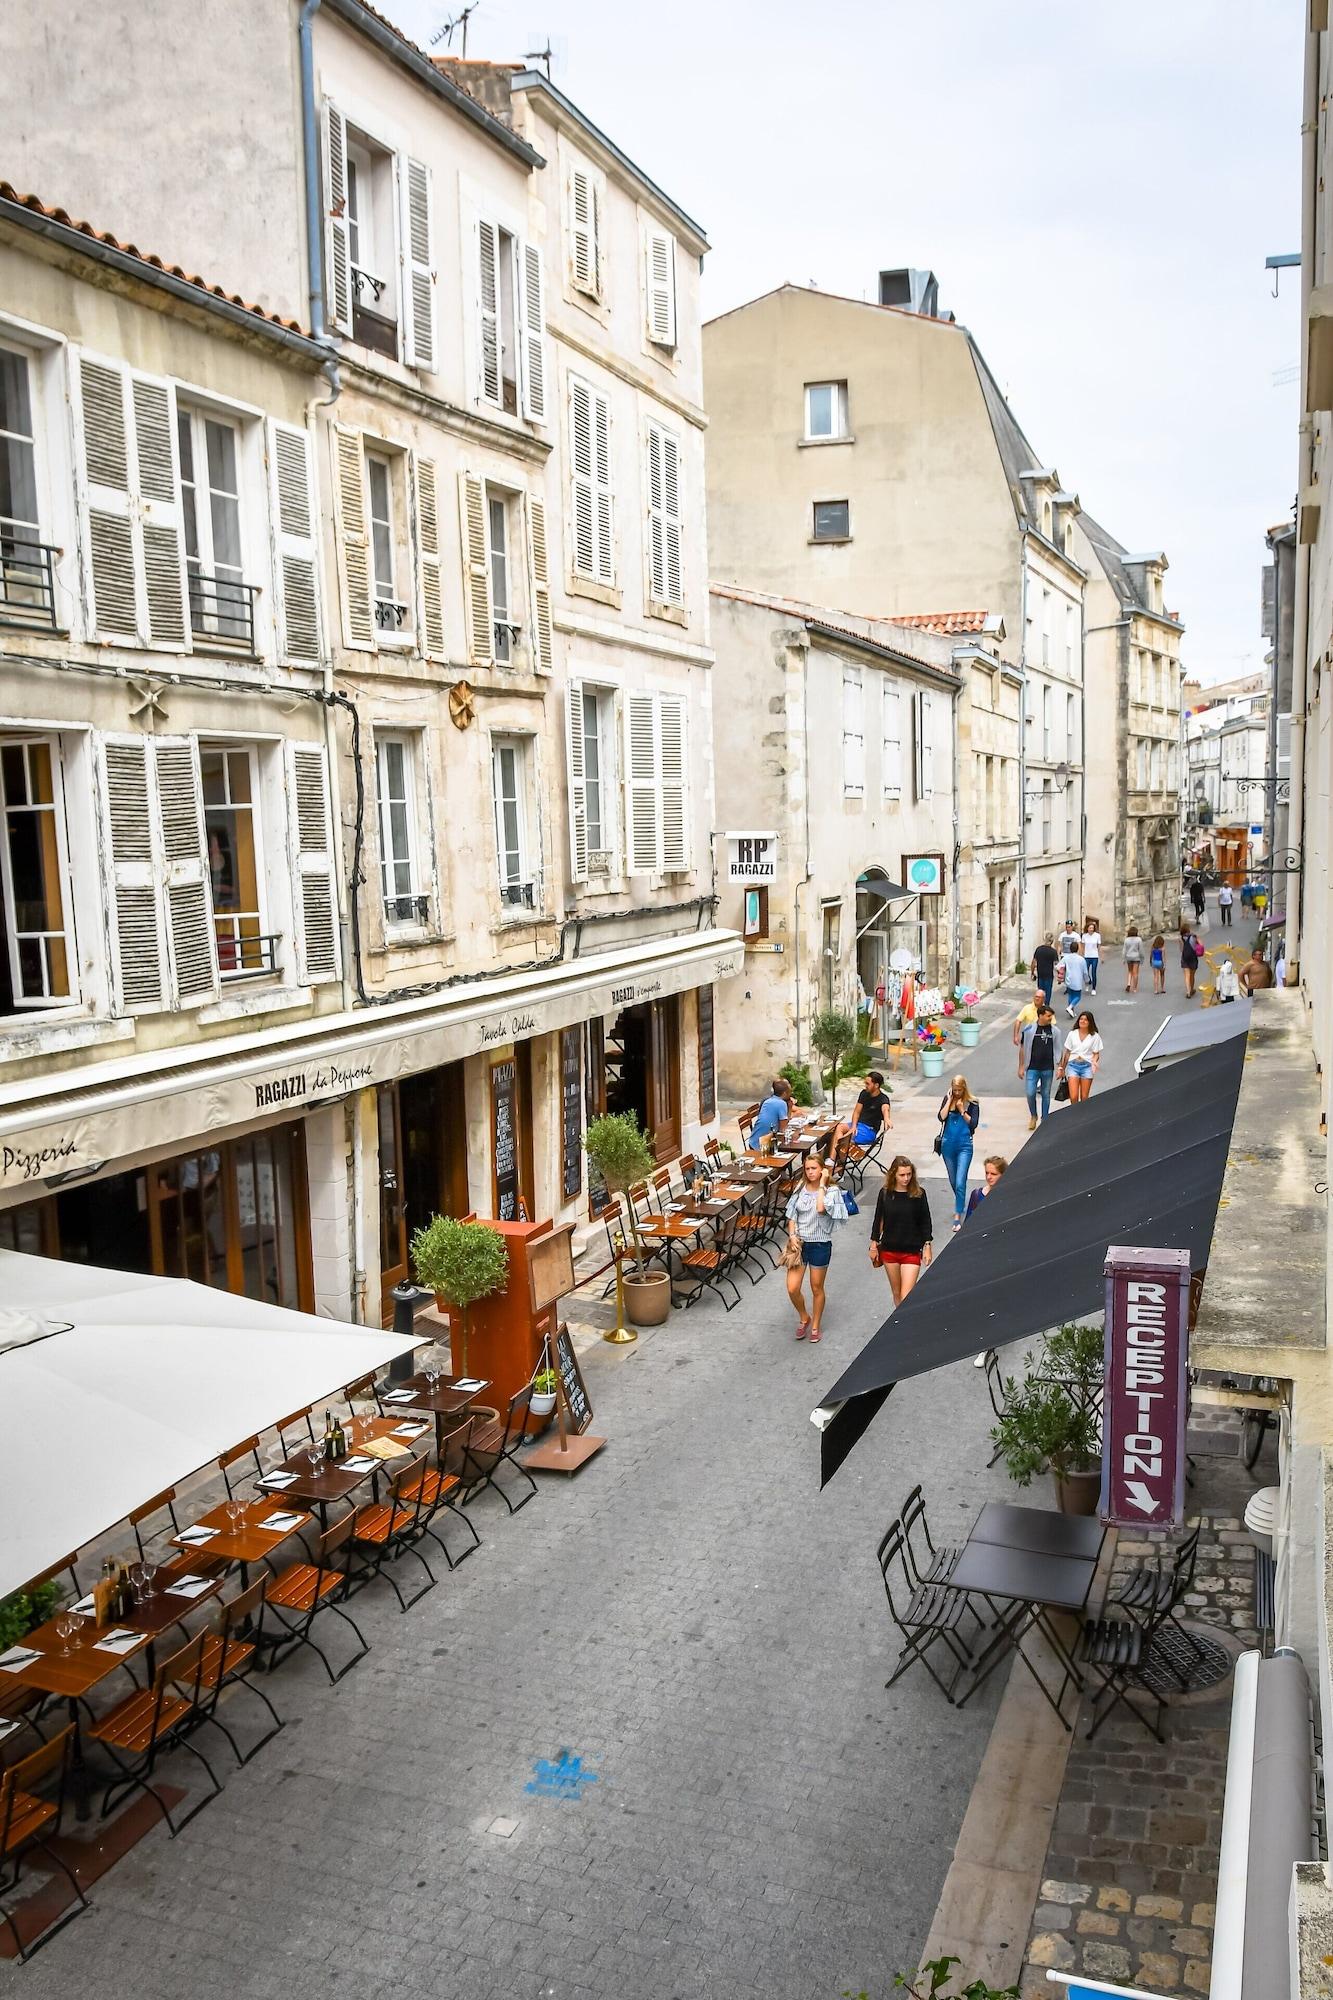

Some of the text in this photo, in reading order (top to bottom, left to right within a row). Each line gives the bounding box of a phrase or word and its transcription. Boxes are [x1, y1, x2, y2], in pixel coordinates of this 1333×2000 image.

[738, 838, 768, 863] RP
[730, 864, 774, 875] RAGAZZI
[611, 985, 635, 1005] RAGAZZI
[255, 1065, 373, 1107] RAGAZZI da Peppone
[3, 1137, 78, 1179] Pizzeria
[1123, 1281, 1167, 1477] RECEPTION
